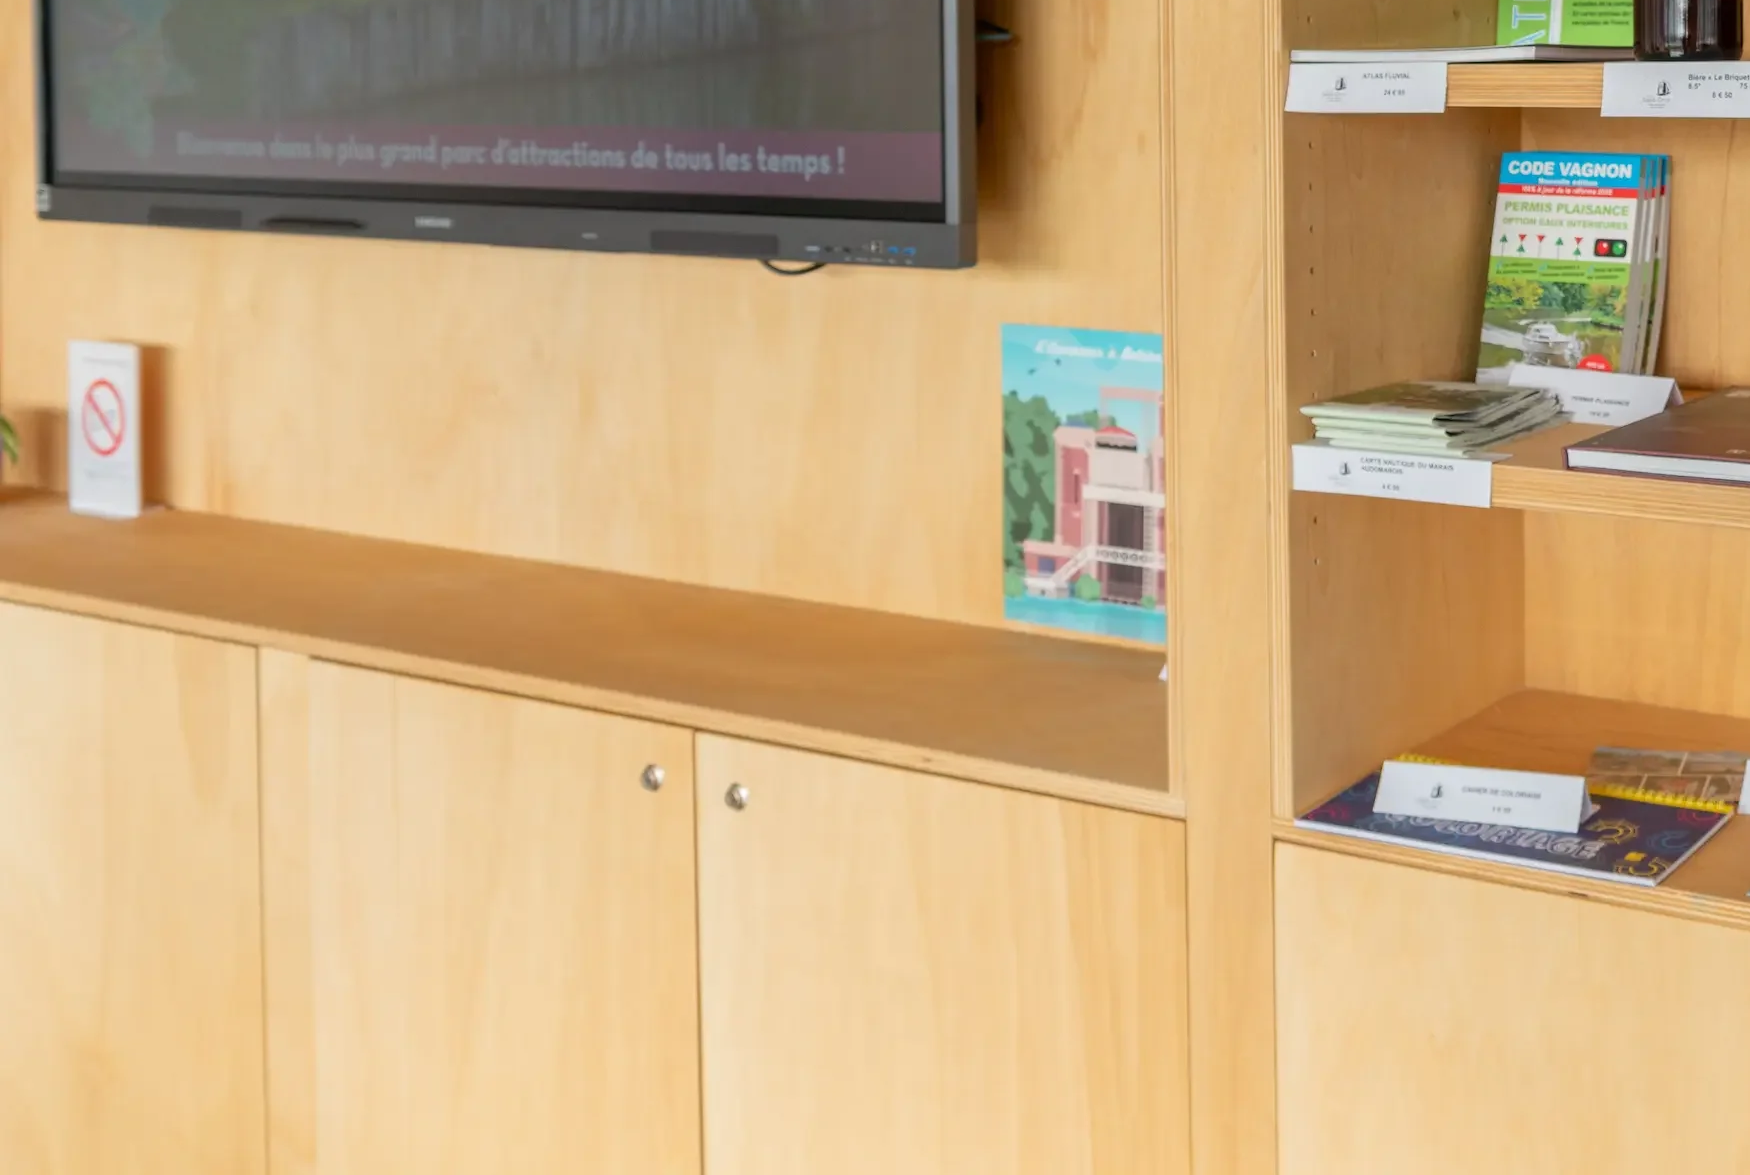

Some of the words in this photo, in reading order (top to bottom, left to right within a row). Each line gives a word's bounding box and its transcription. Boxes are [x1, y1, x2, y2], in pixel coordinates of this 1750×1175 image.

[1688, 73, 1706, 81] Bière
[1724, 73, 1750, 83] Briquet
[1740, 82, 1748, 90] 75
[337, 135, 375, 167] plus
[379, 136, 437, 171] grand
[440, 141, 486, 171] parc
[491, 137, 626, 170] d'attractions
[630, 143, 658, 170] de
[664, 143, 712, 172] tous
[717, 142, 753, 173] les
[757, 145, 832, 181] temps
[1507, 160, 1555, 176] CODE
[1559, 161, 1633, 179] VAGNON
[1503, 200, 1552, 213] PERMIS
[1556, 202, 1629, 217] PLAISANCE
[1502, 217, 1536, 226] OPTION
